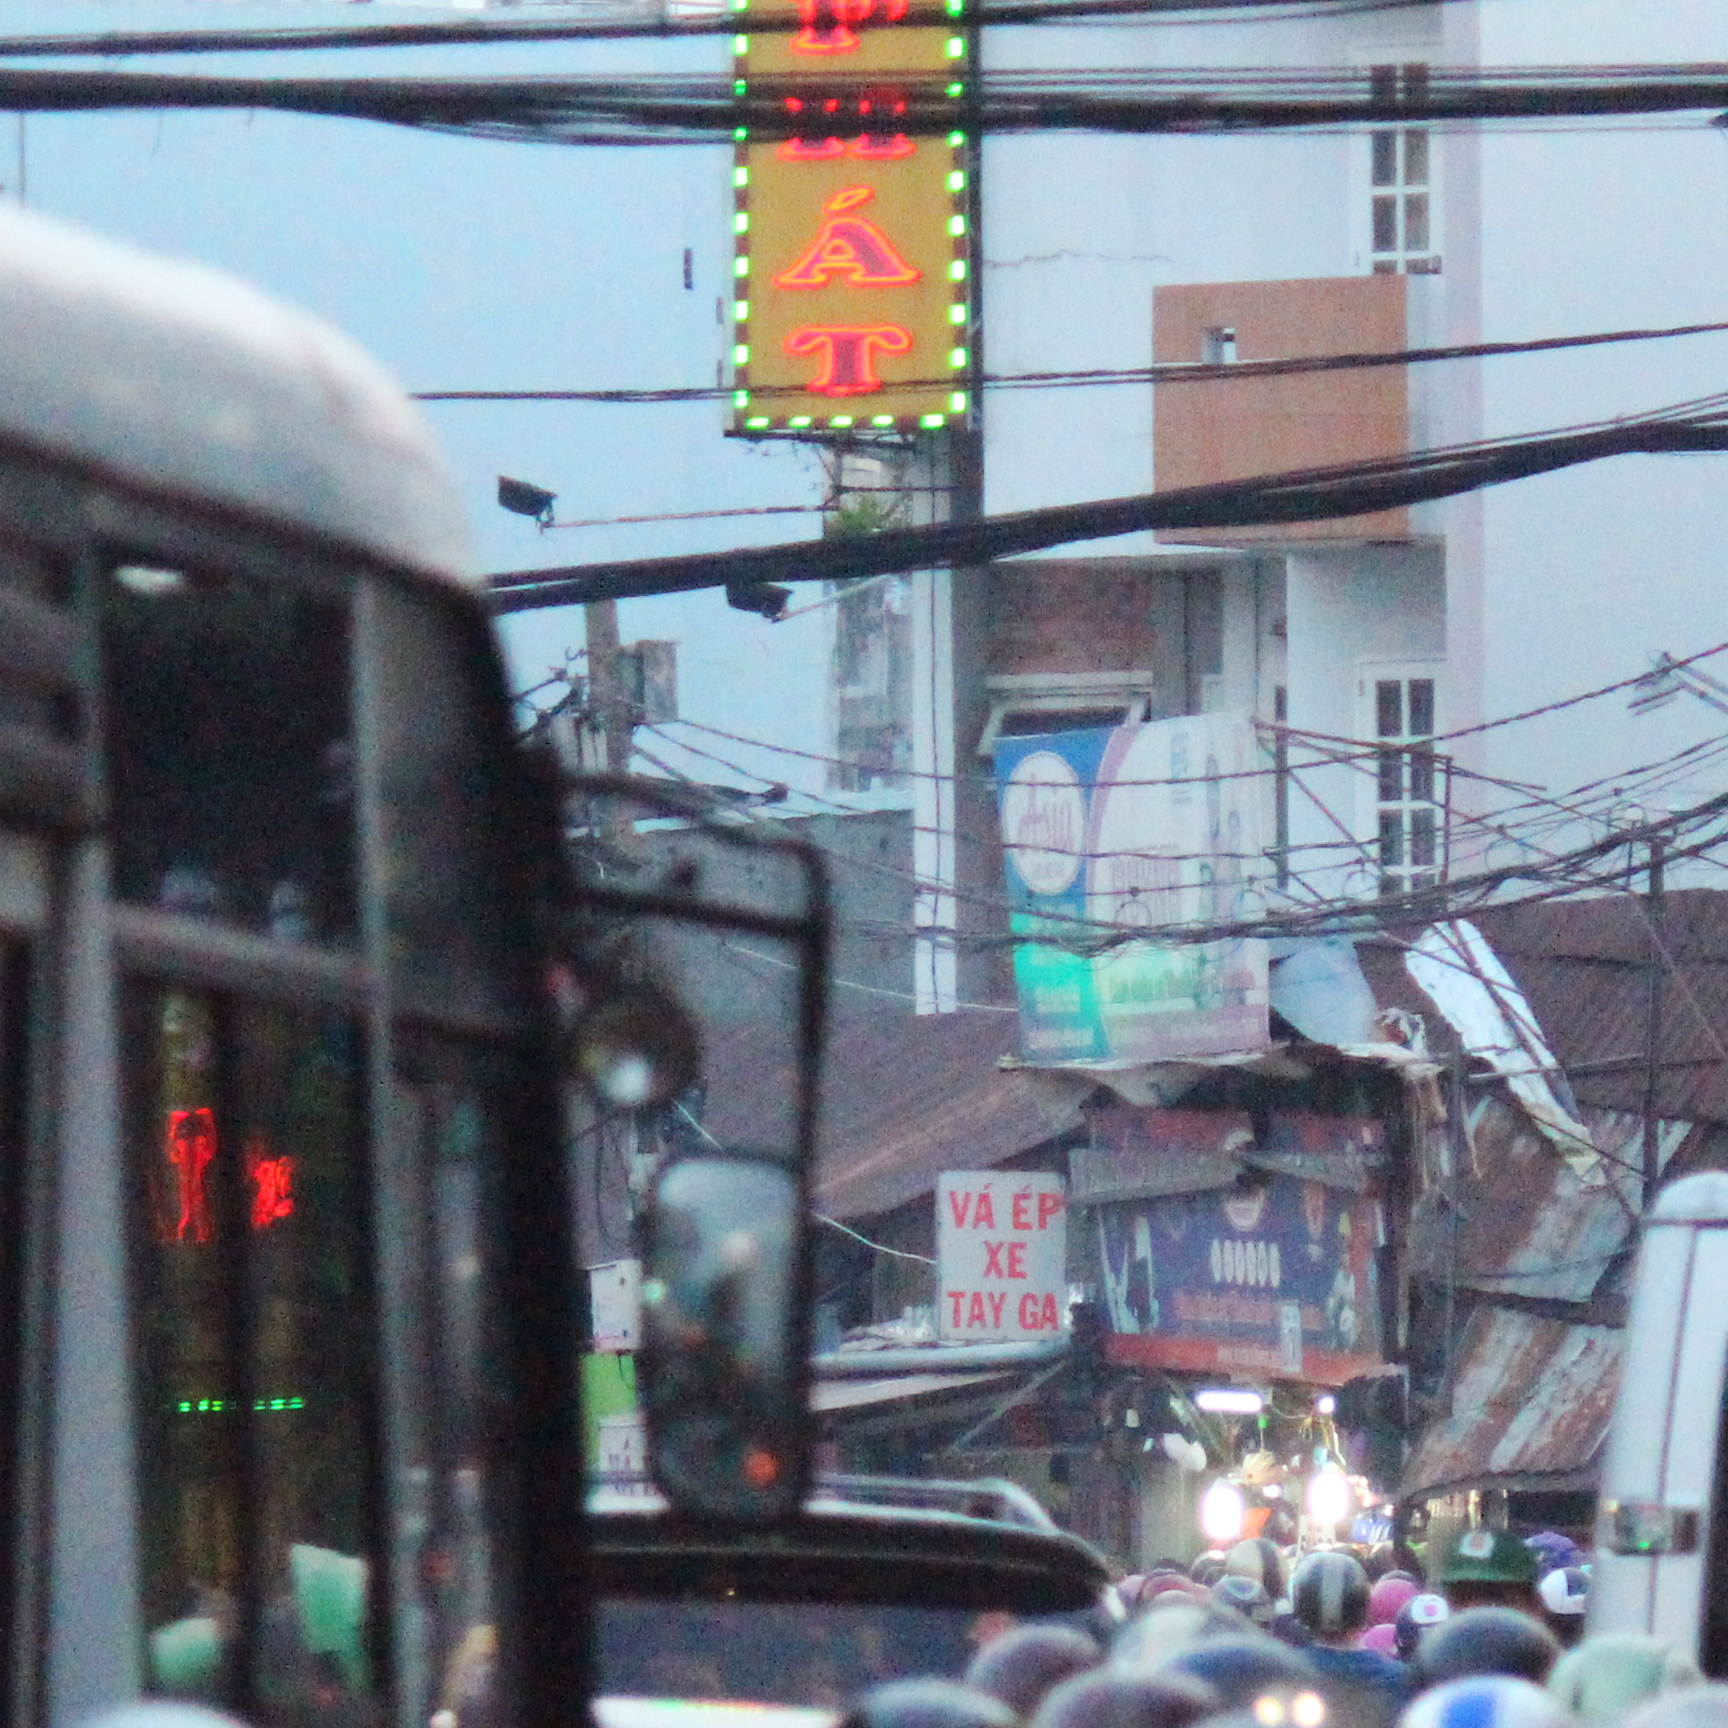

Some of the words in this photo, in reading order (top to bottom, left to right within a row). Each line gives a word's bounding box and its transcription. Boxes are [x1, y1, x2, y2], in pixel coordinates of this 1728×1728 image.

[949, 1182, 996, 1230] VÁ
[1012, 1185, 1068, 1230] ÉP
[983, 1240, 1028, 1279] XE
[947, 1291, 1007, 1329] TAY
[1018, 1292, 1059, 1330] GA
